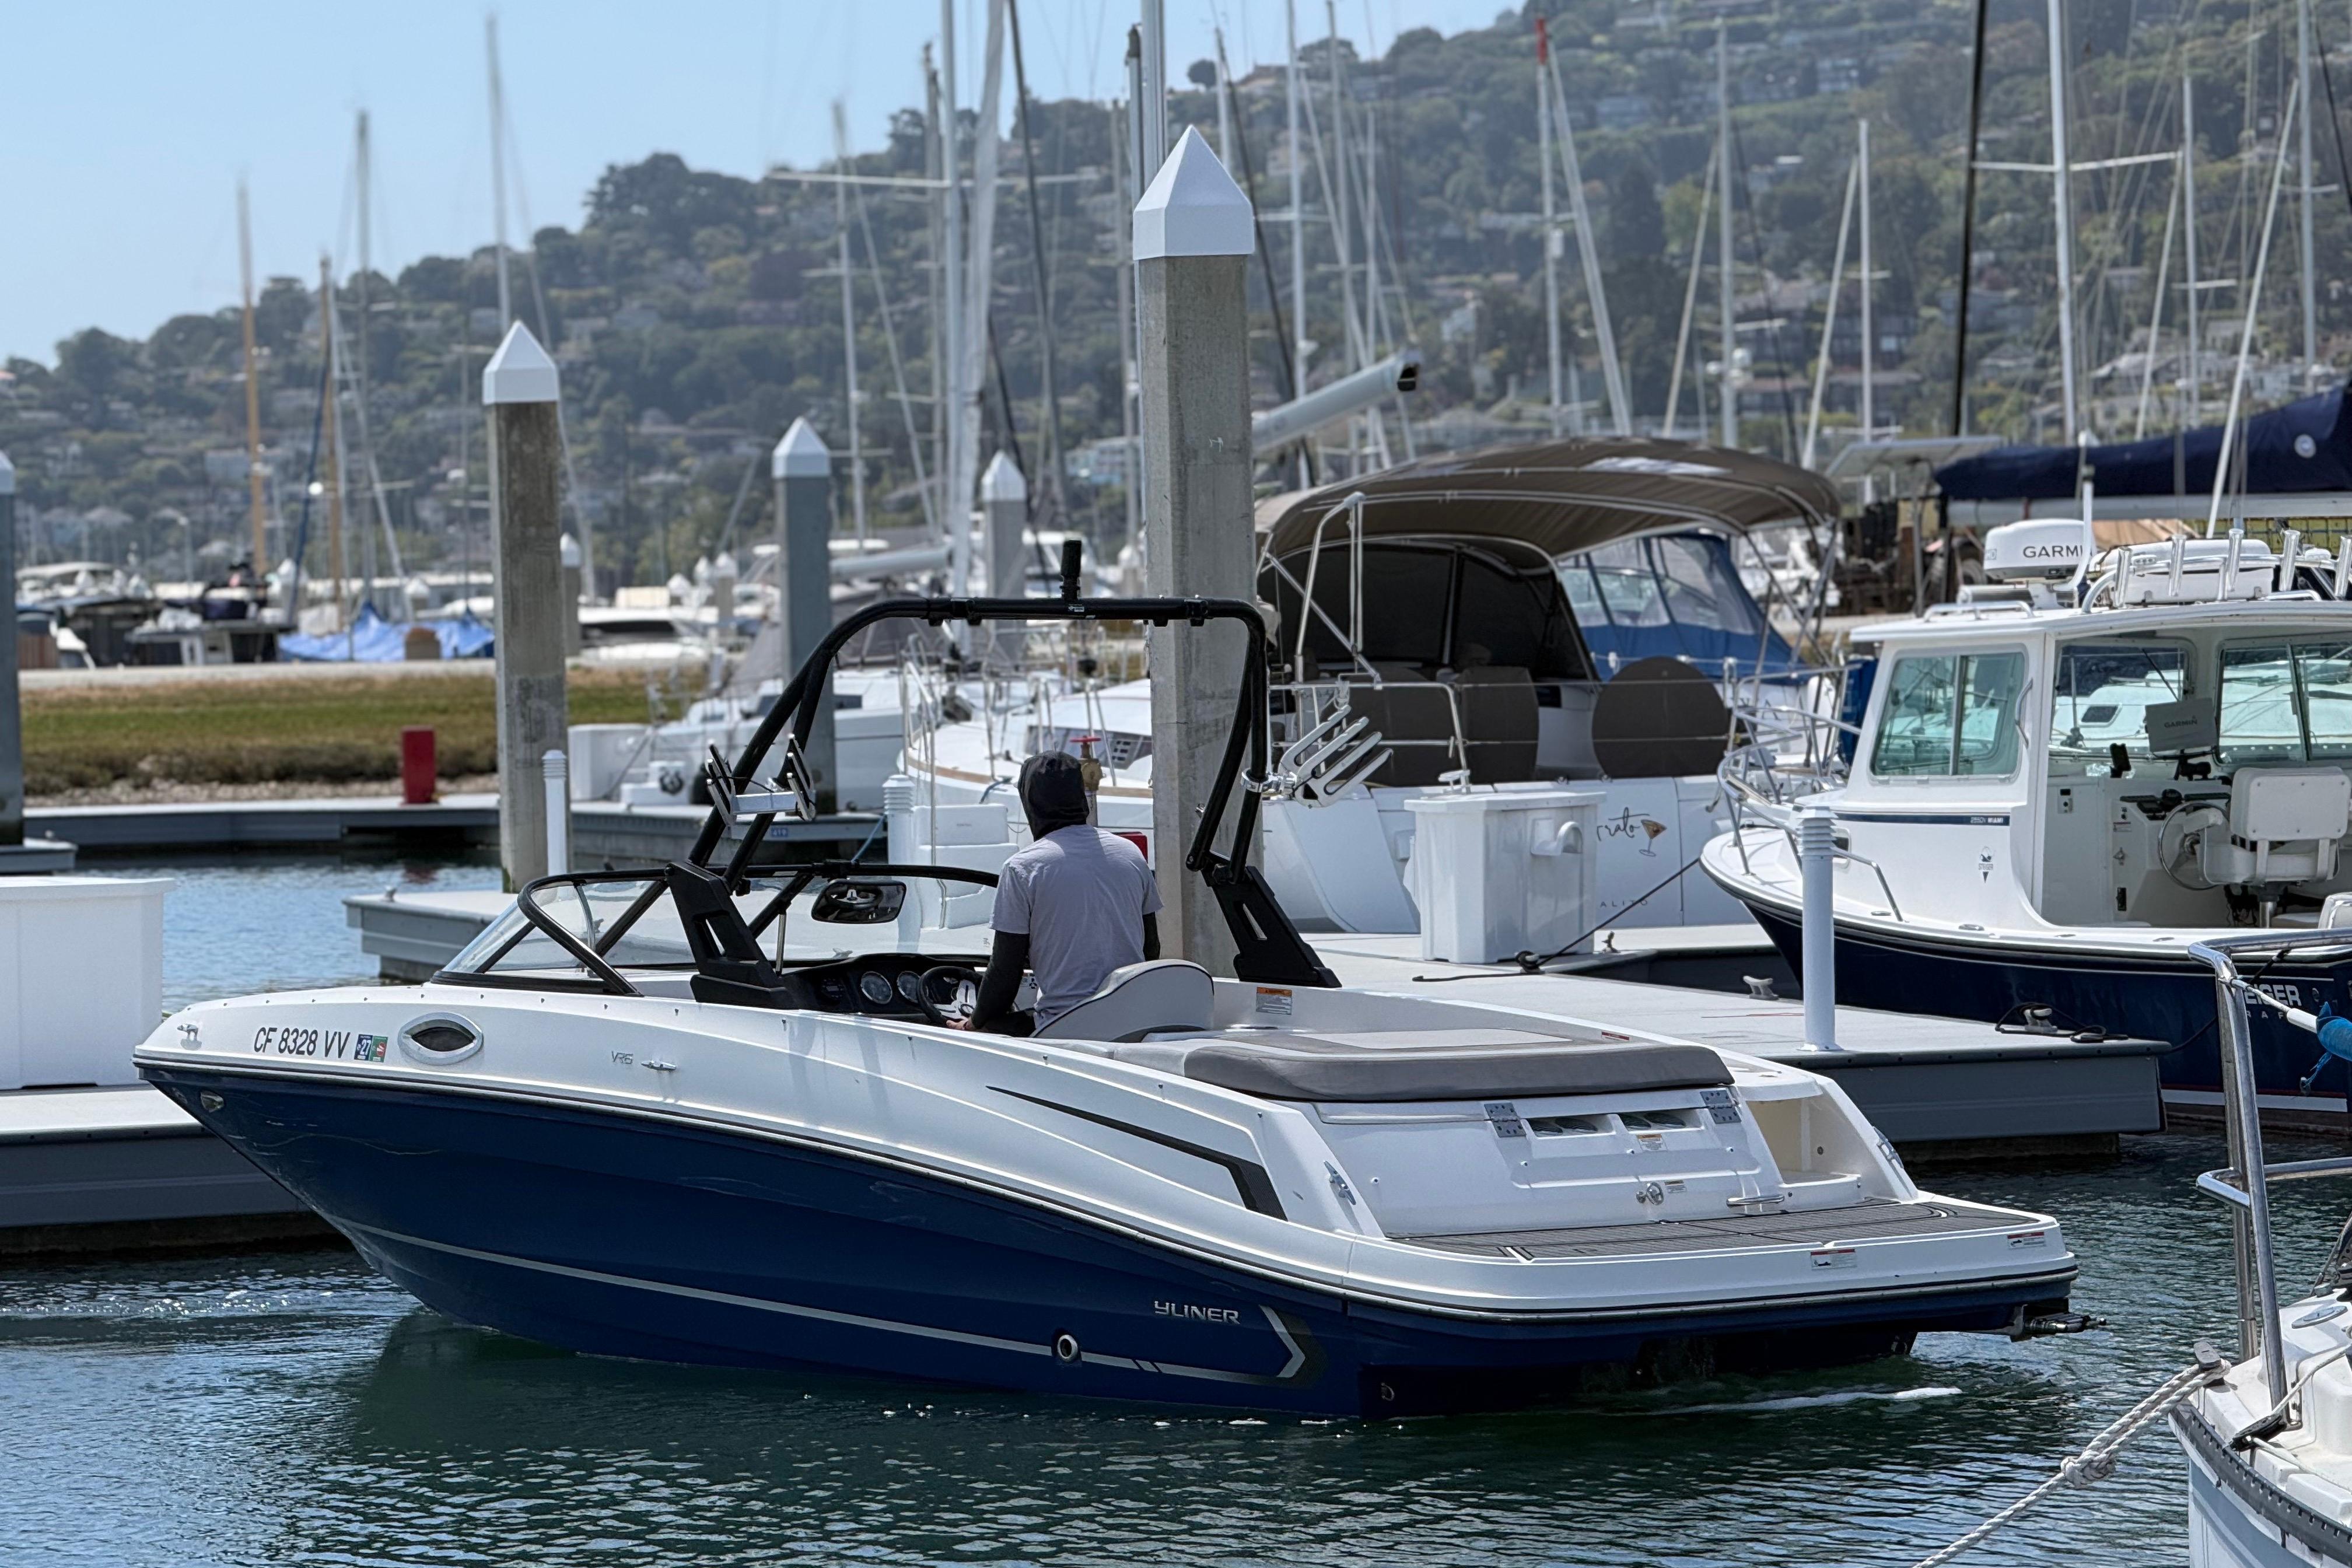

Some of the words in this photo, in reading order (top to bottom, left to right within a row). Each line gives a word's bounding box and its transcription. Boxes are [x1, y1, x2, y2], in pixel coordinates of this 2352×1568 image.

[2023, 545, 2093, 558] GARMI
[2164, 718, 2197, 728] GARMIN
[254, 1027, 278, 1053] CF
[278, 1027, 318, 1056] 8328
[324, 1030, 351, 1059] VV
[359, 1039, 372, 1055] 27
